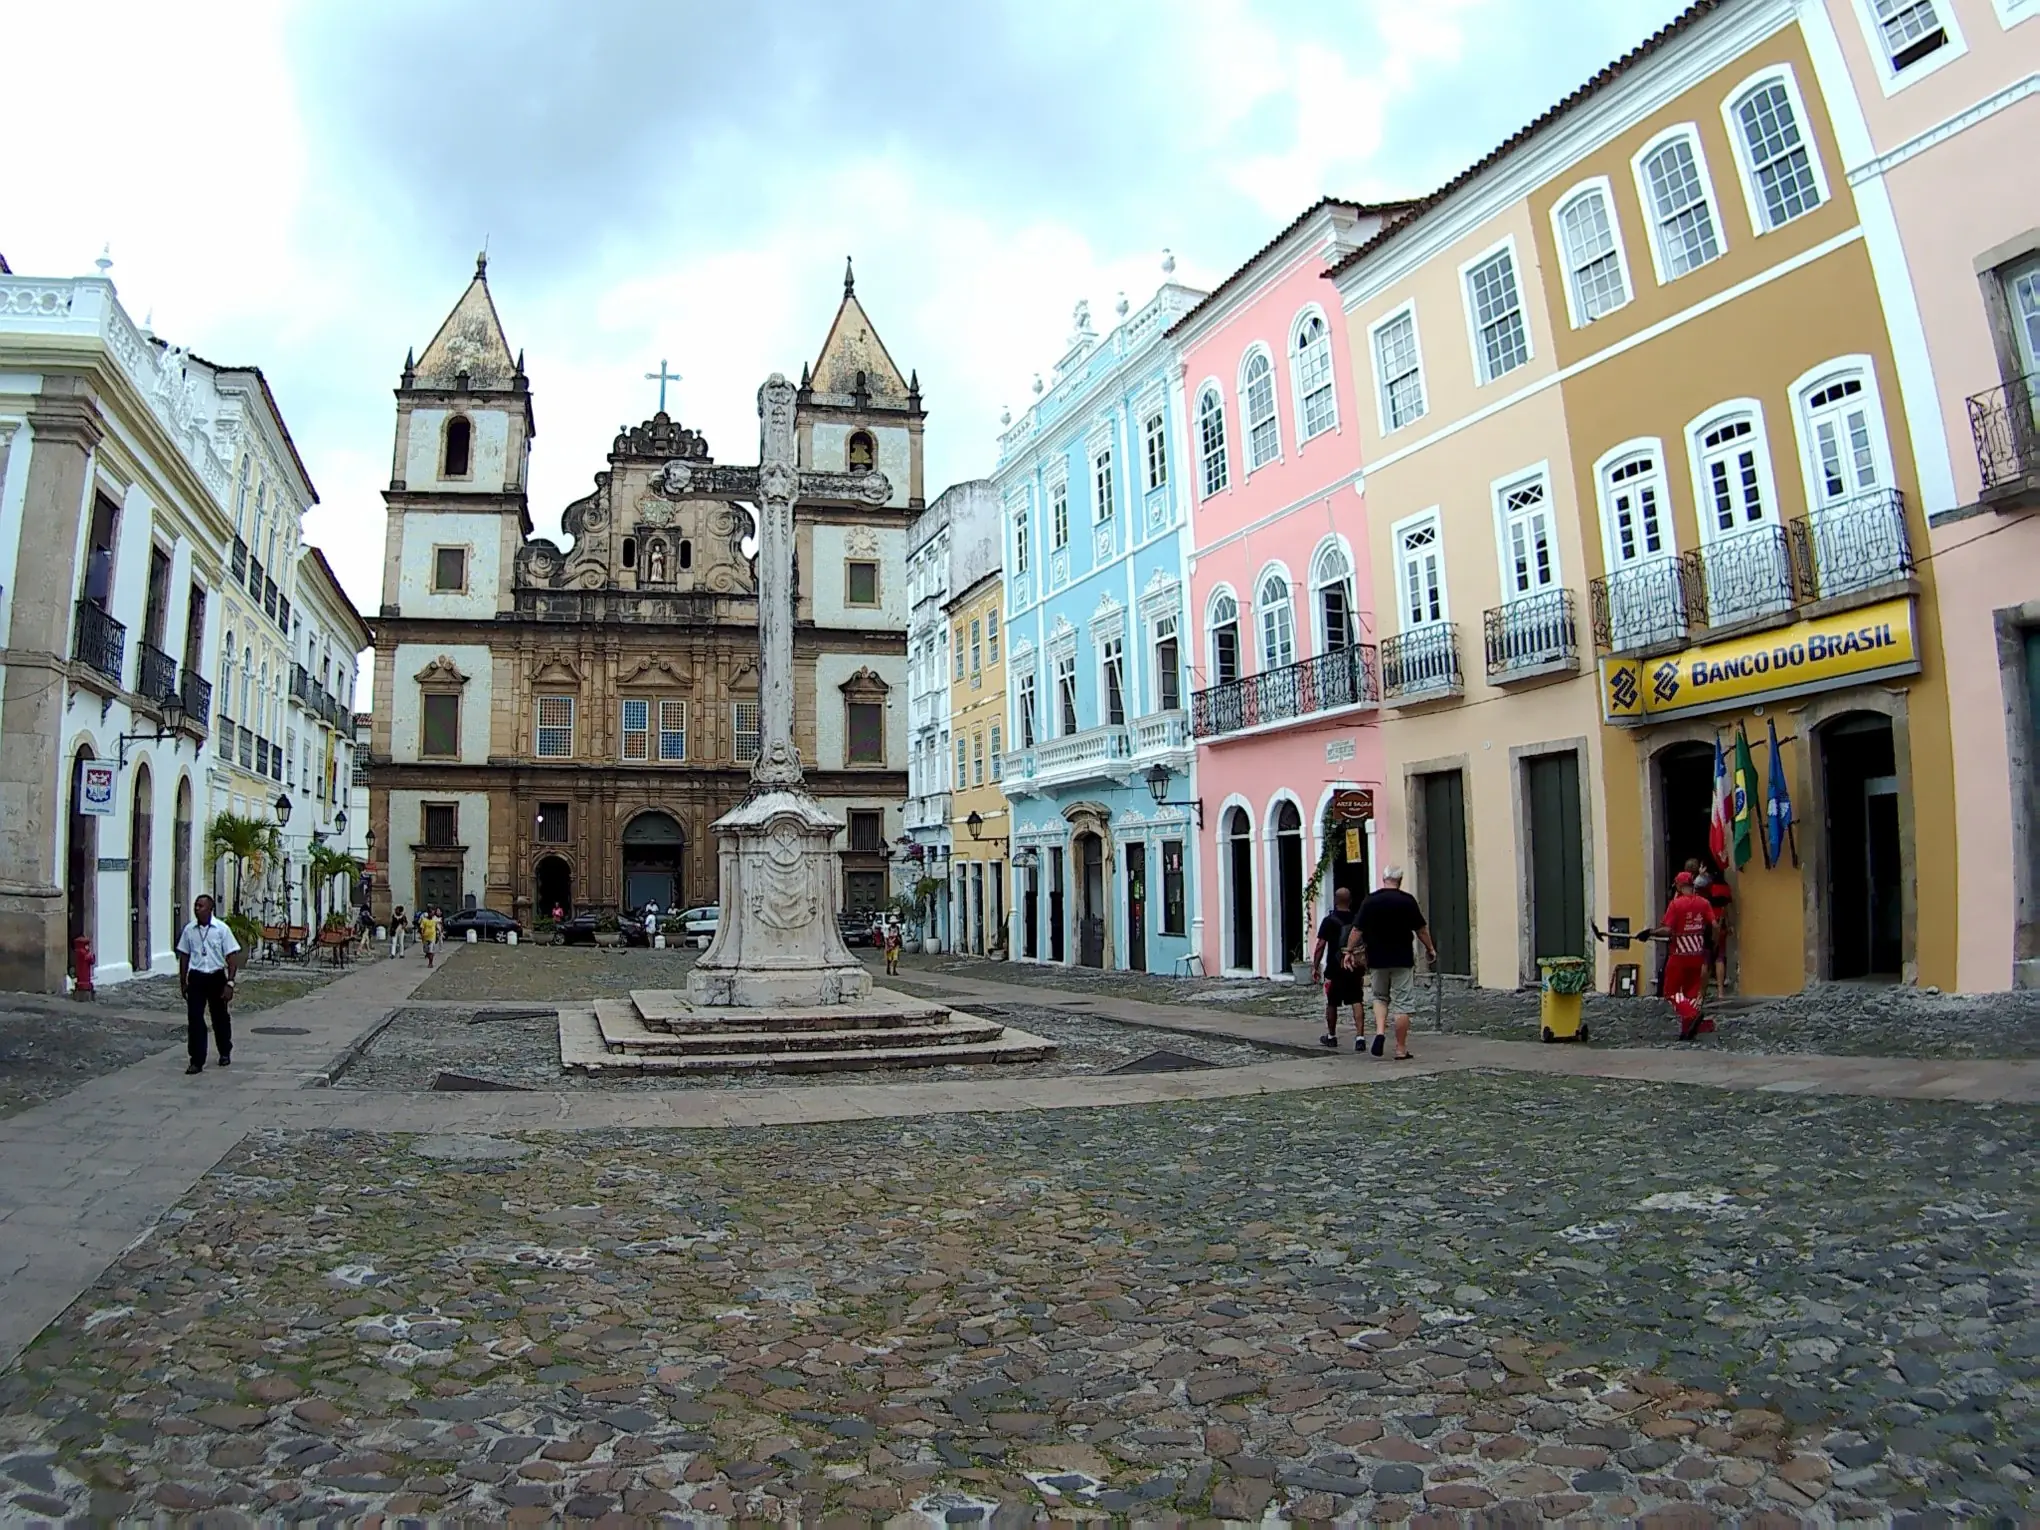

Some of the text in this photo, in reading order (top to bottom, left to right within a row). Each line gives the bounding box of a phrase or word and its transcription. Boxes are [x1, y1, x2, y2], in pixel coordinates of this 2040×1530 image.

[1691, 623, 1897, 687] BANCO DO BRASIL
